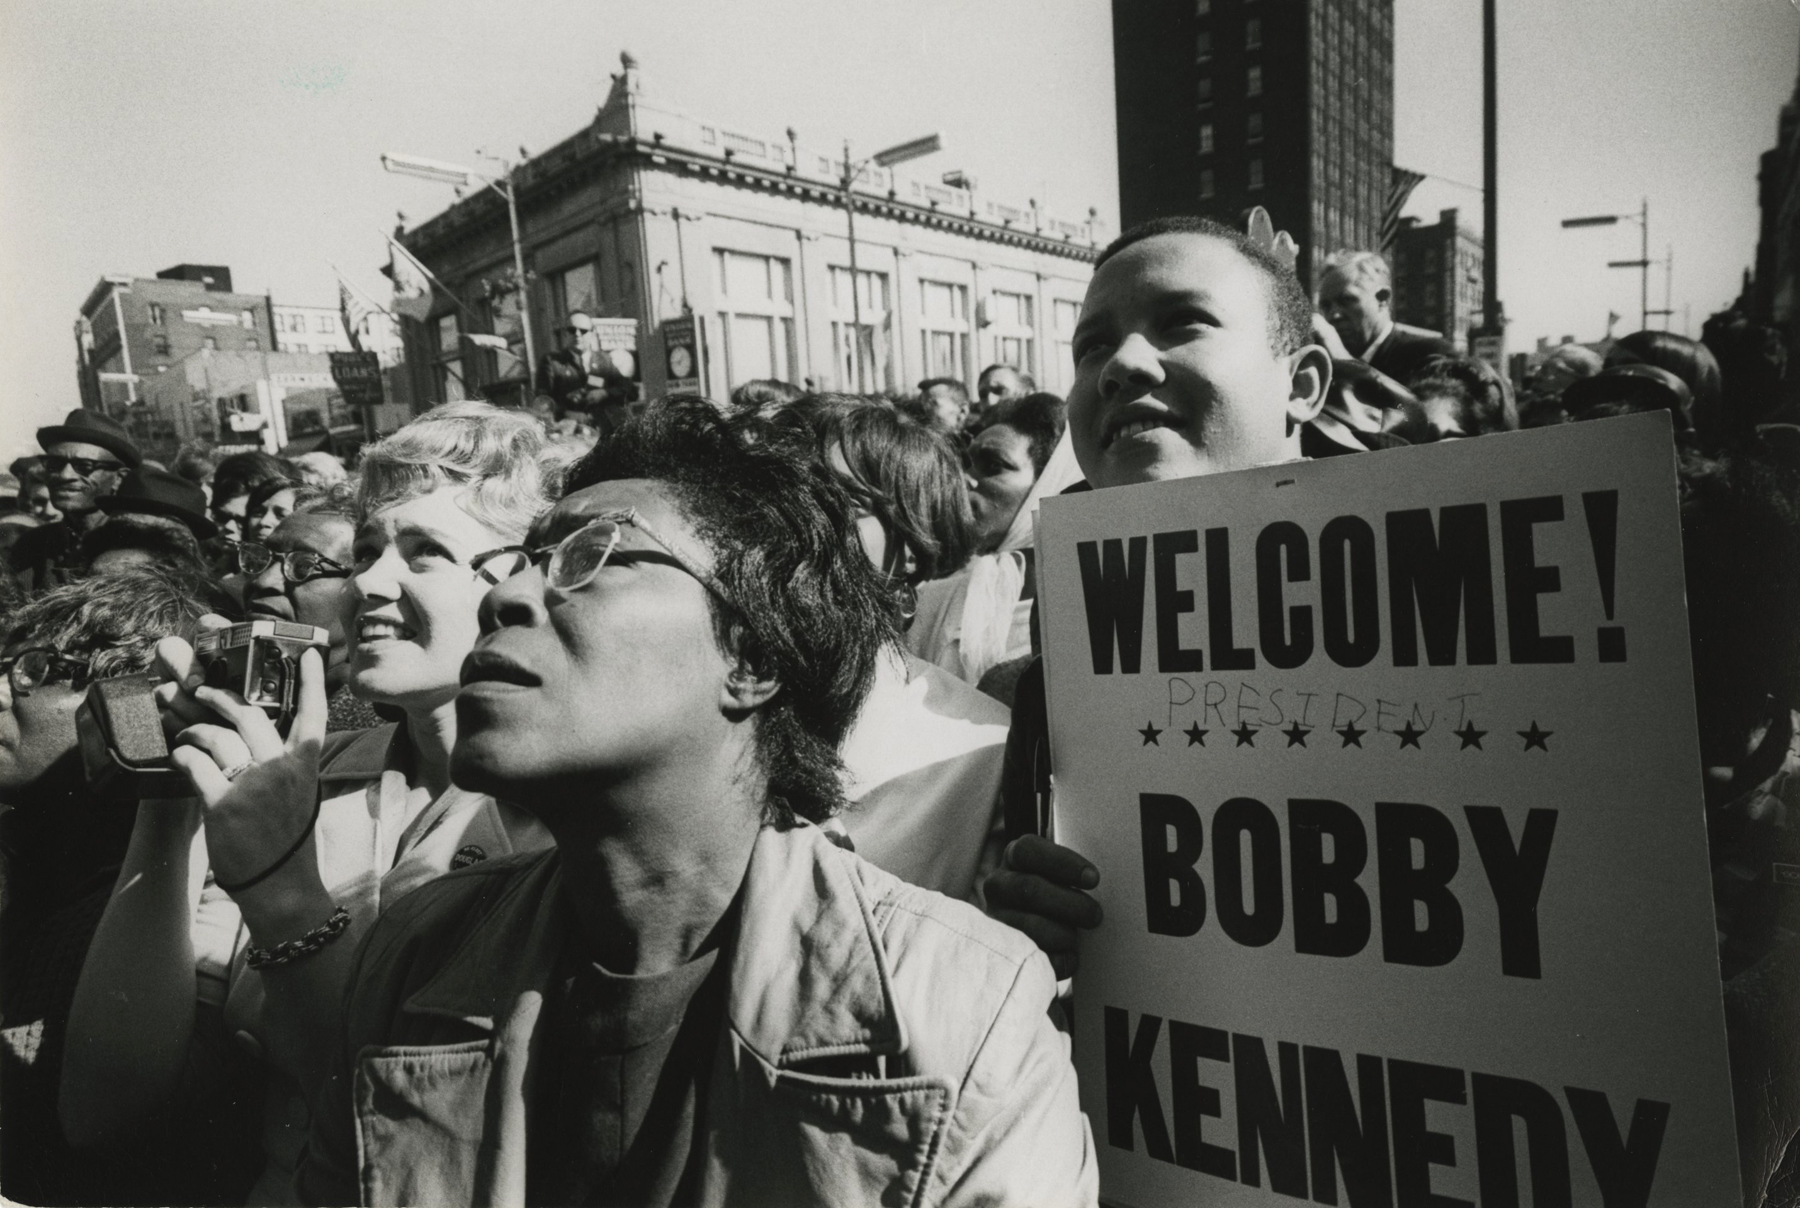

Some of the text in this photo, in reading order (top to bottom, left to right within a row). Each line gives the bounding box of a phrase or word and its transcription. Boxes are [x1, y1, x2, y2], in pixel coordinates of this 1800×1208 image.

[334, 366, 379, 381] LOANS
[1077, 489, 1627, 675] WELCOME!
[1168, 677, 1481, 734] PRESIDENT
[1140, 792, 1560, 980] BOBBY
[1104, 1005, 1672, 1208] KENNEDY
